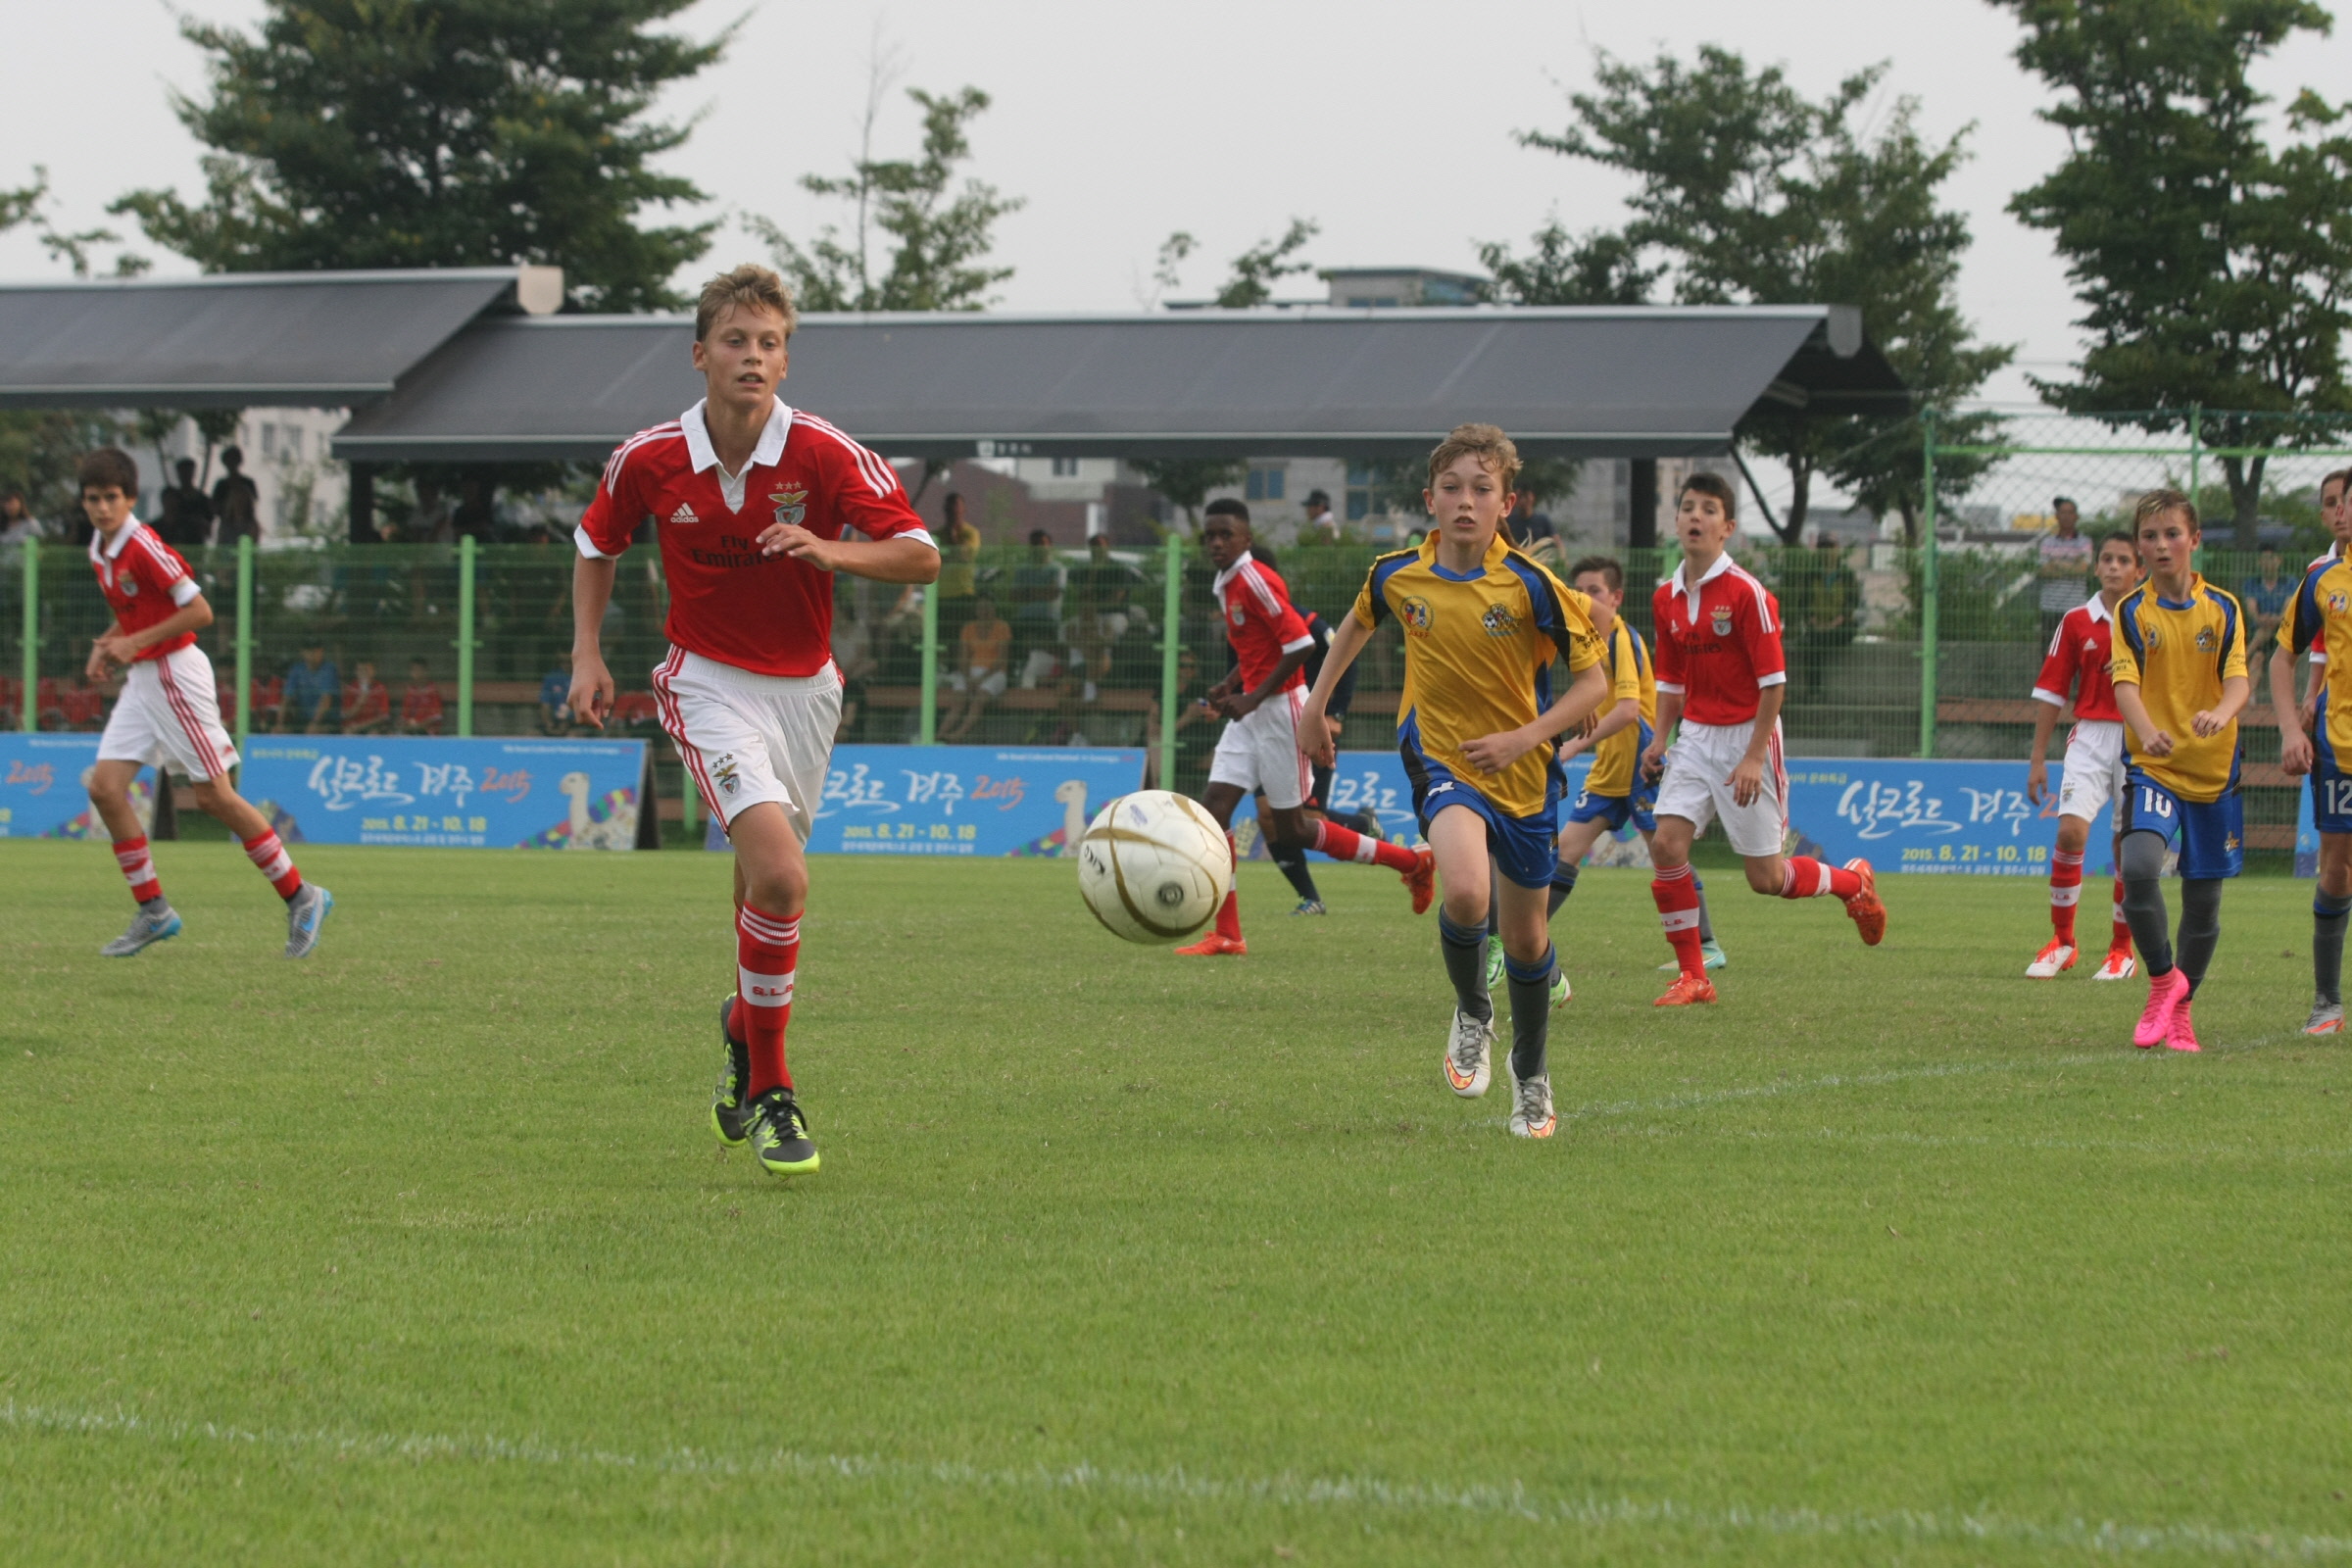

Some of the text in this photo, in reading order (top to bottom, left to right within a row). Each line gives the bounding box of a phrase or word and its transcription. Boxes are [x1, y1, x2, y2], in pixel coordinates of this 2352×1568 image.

[670, 514, 699, 523] adidas
[721, 535, 749, 551] Fly
[6, 760, 54, 796] 2015
[308, 754, 534, 810] 실크로드 경주 2015
[812, 762, 1029, 820] 크로드 경주 2015
[1836, 780, 1963, 840] 실크로드
[1959, 787, 2032, 838] 경주
[2141, 785, 2173, 818] 10
[2325, 778, 2352, 814] 12
[412, 815, 429, 831] 21
[897, 823, 915, 839] 21
[957, 824, 977, 840] 18
[1901, 847, 1936, 861] 2015.
[1939, 844, 1956, 861] 8.
[1960, 845, 1980, 861] 21
[1996, 845, 2022, 862] 10.
[2027, 846, 2047, 862] 18
